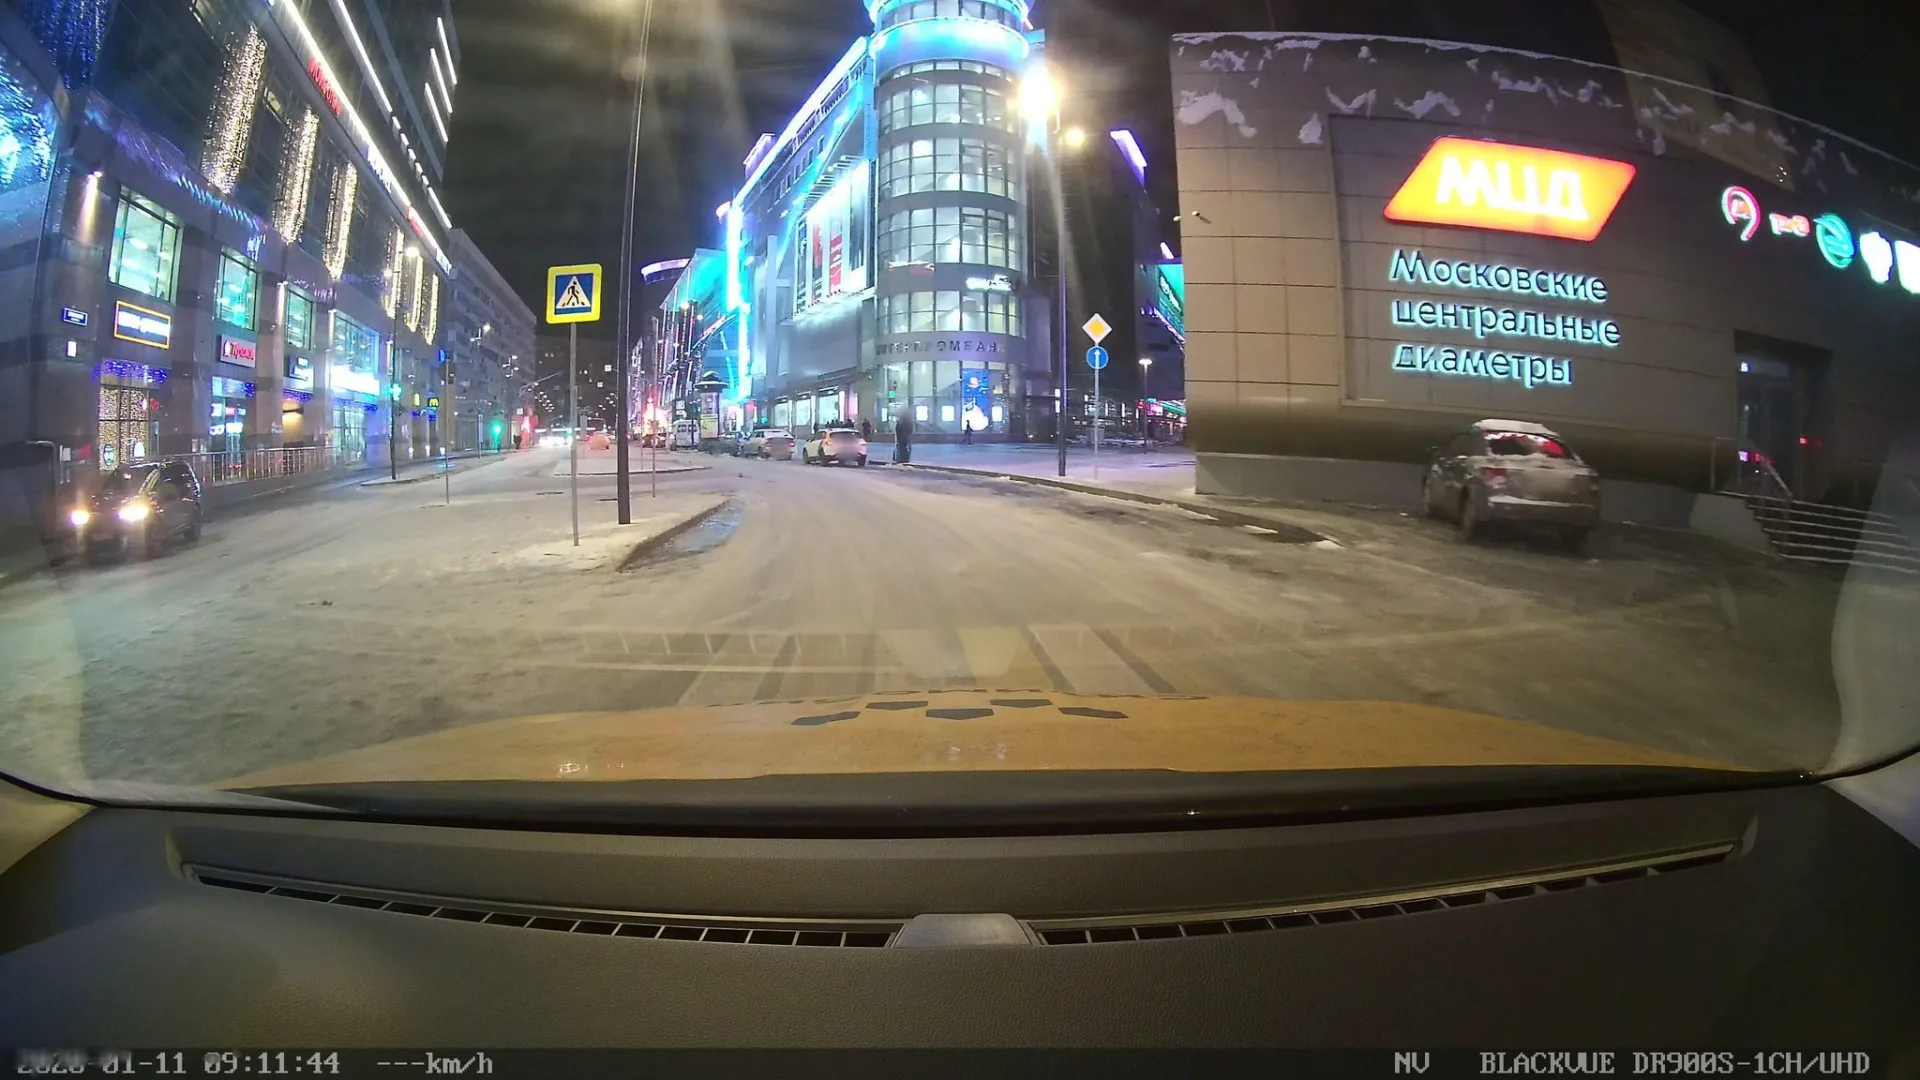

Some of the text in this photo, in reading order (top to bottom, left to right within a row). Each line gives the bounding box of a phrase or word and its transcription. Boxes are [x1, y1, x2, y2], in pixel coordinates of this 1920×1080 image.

[1436, 155, 1590, 221] МЦД
[1389, 249, 1609, 303] Московские
[1391, 299, 1621, 347] центральные
[1391, 343, 1573, 388] диаметры
